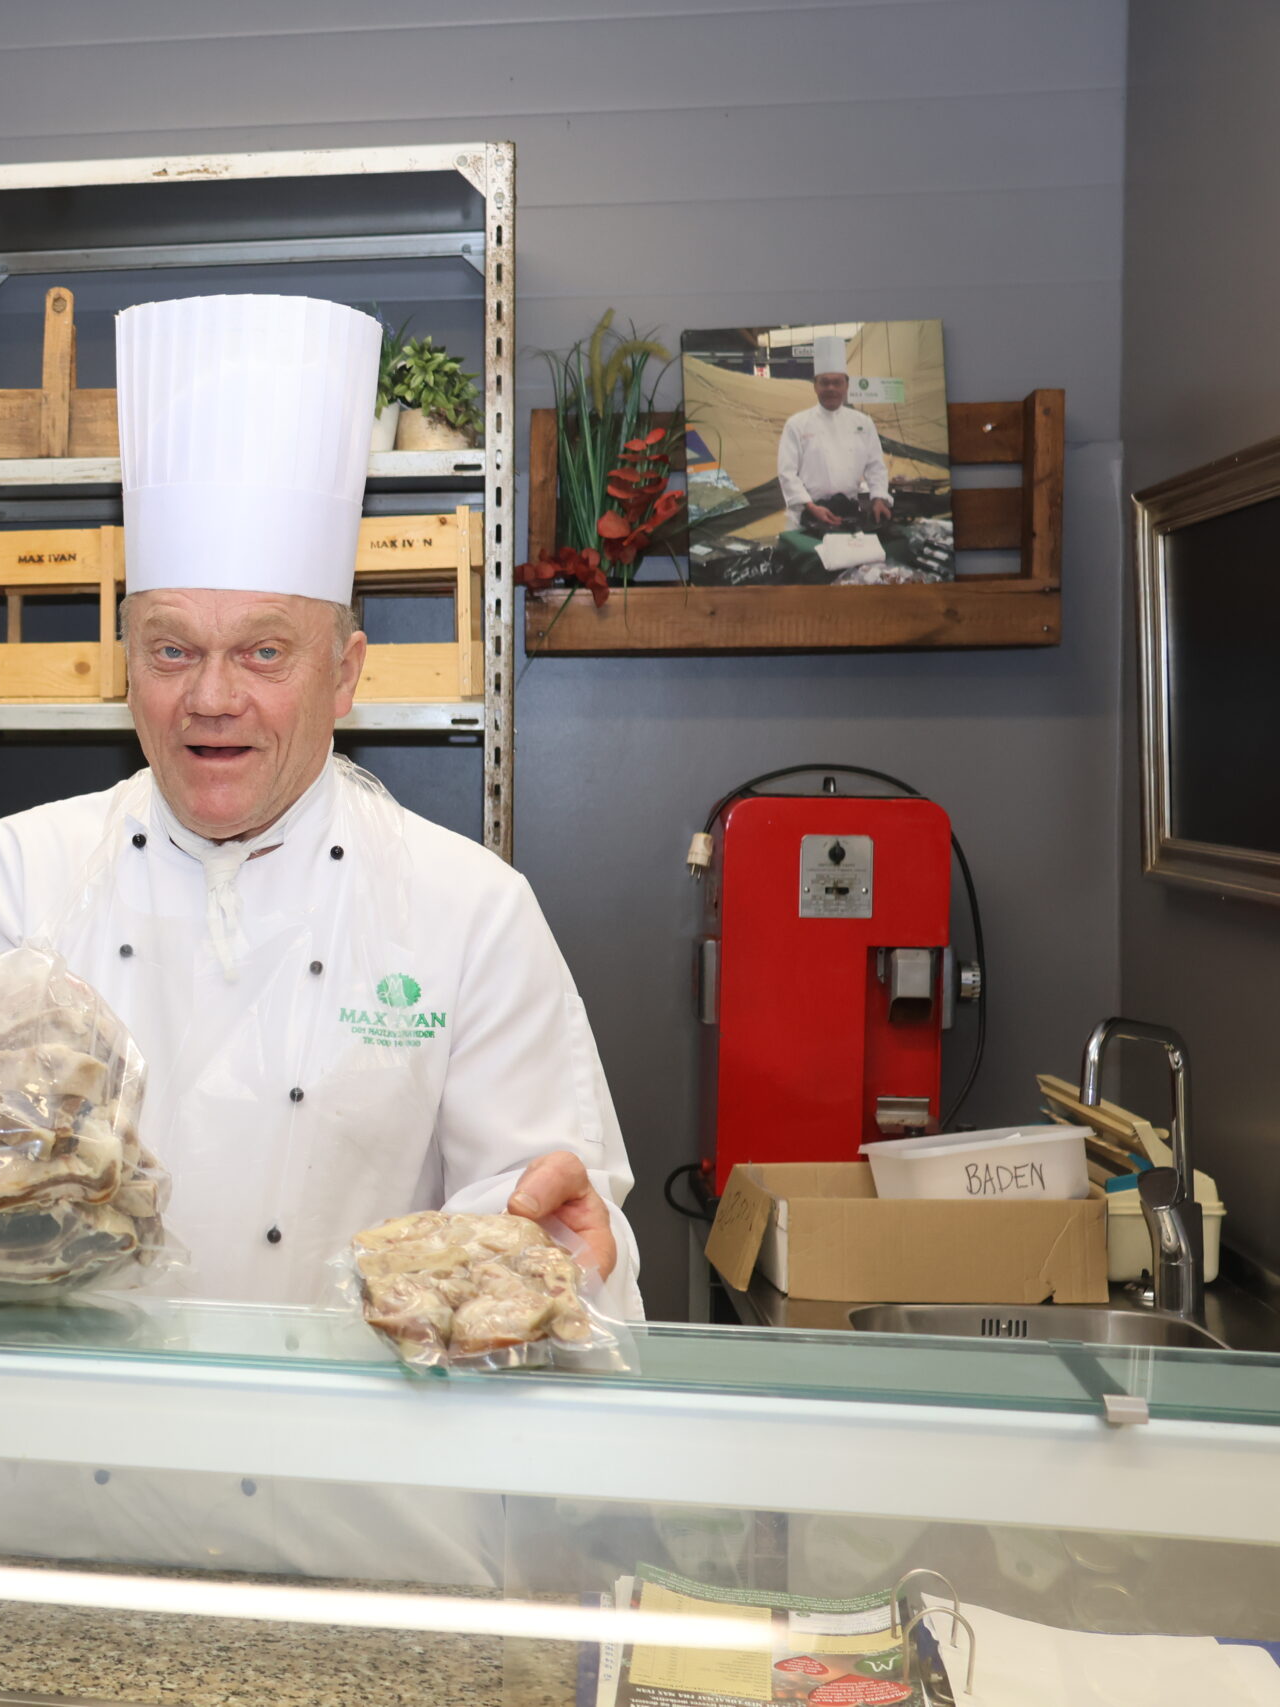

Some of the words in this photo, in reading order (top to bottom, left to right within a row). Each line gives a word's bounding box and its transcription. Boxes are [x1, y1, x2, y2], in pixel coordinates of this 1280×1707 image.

[370, 539, 398, 549] MAX
[402, 538, 433, 549] IVN
[17, 554, 45, 564] MAX
[48, 553, 78, 563] IVAN
[339, 1007, 388, 1027] MAX
[395, 1011, 447, 1029] VAN
[964, 1162, 1046, 1195] BADEN
